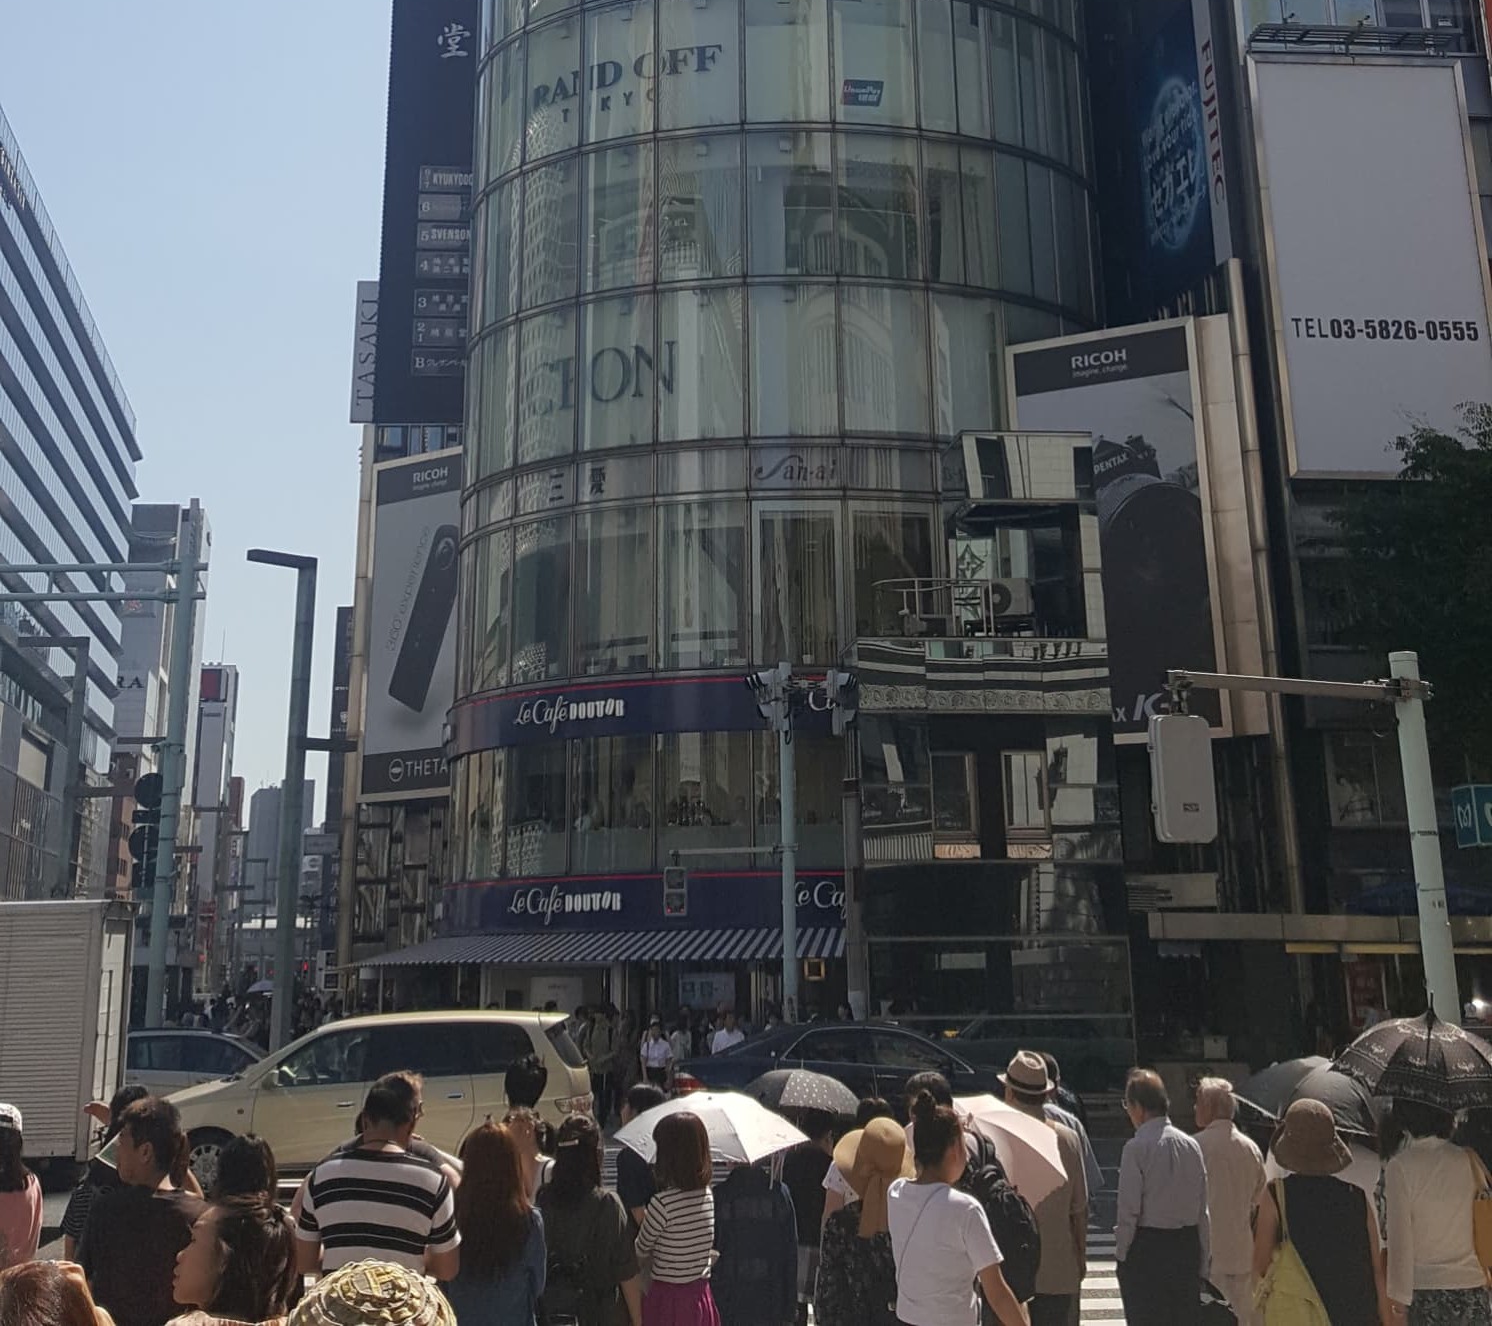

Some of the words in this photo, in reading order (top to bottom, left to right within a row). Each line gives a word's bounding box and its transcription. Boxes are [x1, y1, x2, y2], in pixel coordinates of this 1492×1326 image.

[1201, 40, 1225, 205] FUJITEC
[418, 297, 427, 309] 3
[356, 299, 379, 407] TASAKI
[414, 357, 425, 369] B
[1071, 347, 1127, 369] RICOH
[412, 466, 449, 483] RICOH
[1093, 451, 1129, 475] PENTAX
[532, 695, 569, 735] Café
[569, 697, 625, 721] DOUTOR
[405, 757, 448, 779] THETA
[526, 884, 564, 926] Café
[564, 890, 621, 913] DOUTOR
